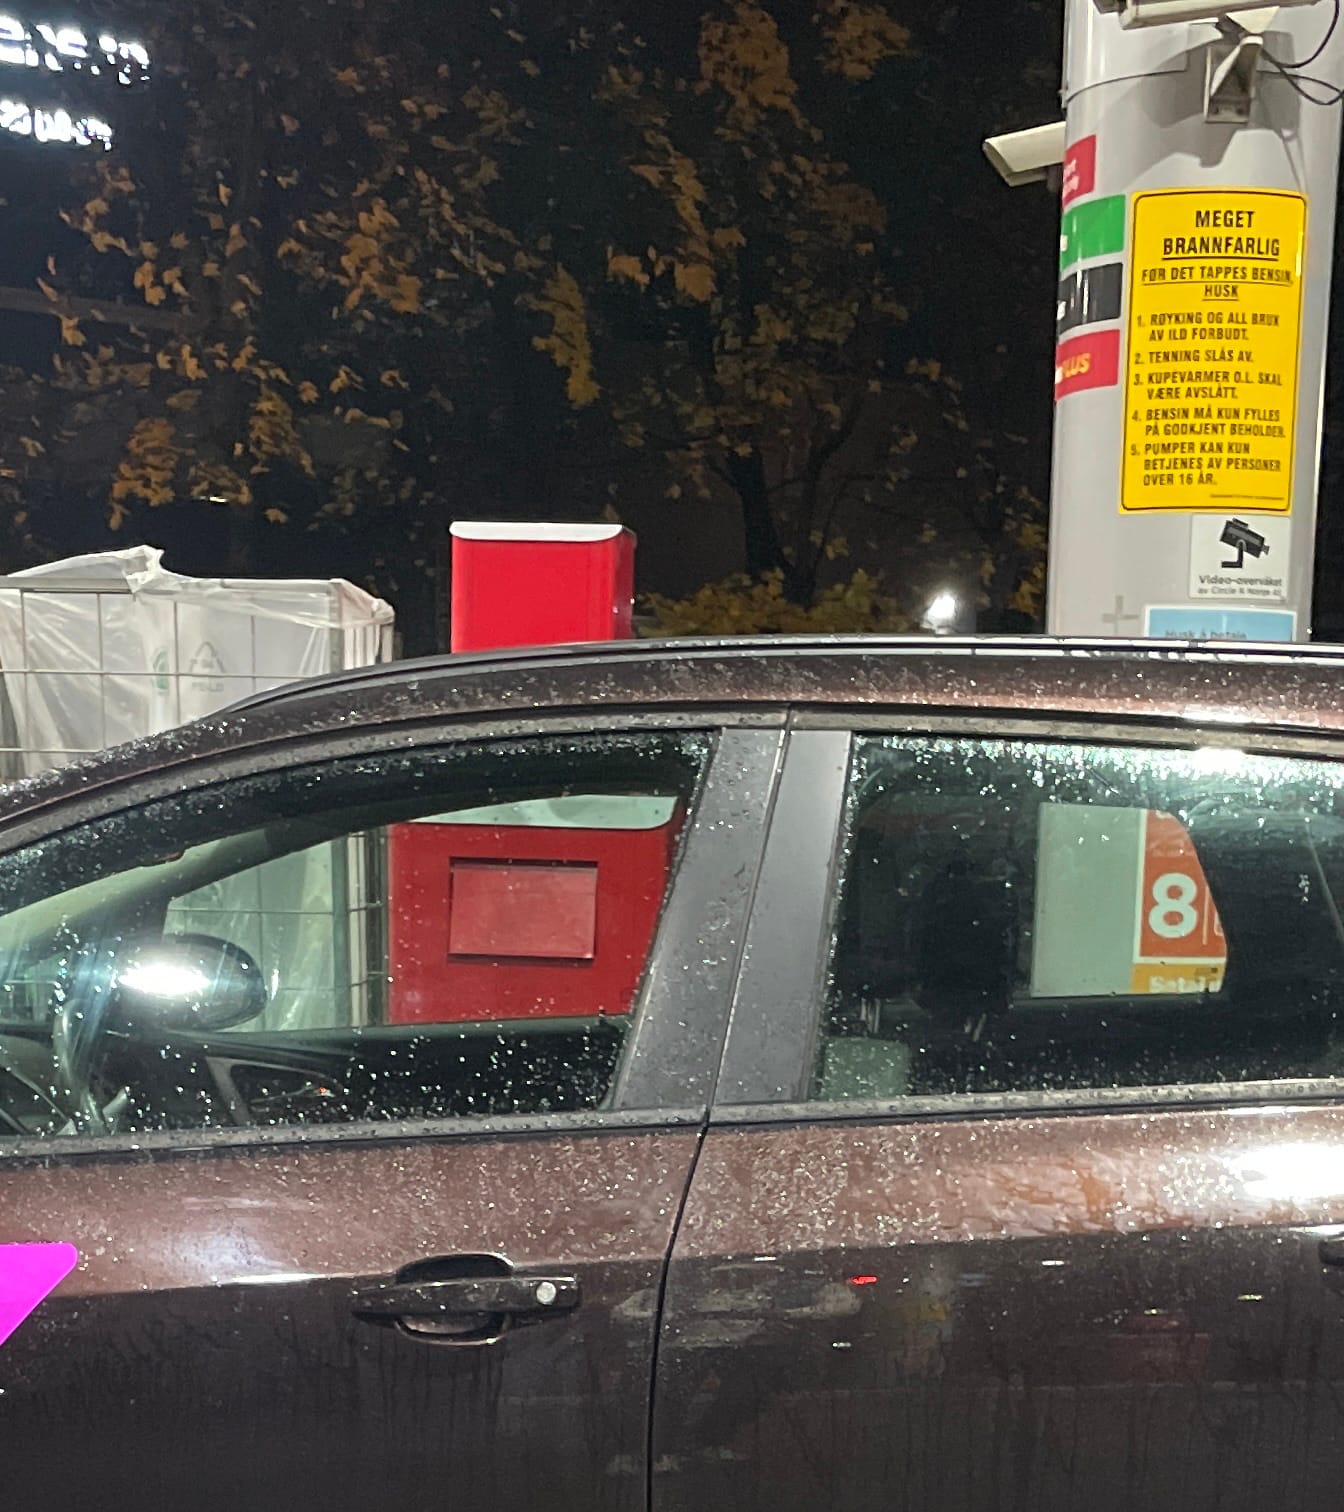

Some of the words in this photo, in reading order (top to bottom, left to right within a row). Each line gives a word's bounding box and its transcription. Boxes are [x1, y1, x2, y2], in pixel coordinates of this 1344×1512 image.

[1195, 210, 1255, 228] MEGET
[1163, 237, 1280, 256] BRANNFARLIG
[1171, 266, 1194, 280] DET
[1200, 266, 1247, 280] TAPPES
[1204, 285, 1238, 297] HUSK
[1207, 312, 1223, 324] OG
[1228, 312, 1247, 324] ALL
[1251, 313, 1279, 326] BRUK
[1149, 329, 1164, 341] AV
[1169, 329, 1187, 341] ILD
[1149, 350, 1200, 363] TENNING
[1147, 371, 1230, 384] KUPEVARMER
[1258, 372, 1282, 386] SKAL
[1147, 387, 1180, 400] VÆRE
[1146, 408, 1189, 421] BENSIN
[1194, 404, 1212, 419] MÅ
[1217, 408, 1240, 419] KUN
[1244, 409, 1280, 422] FYLLES
[1145, 421, 1159, 436] PÅ
[1164, 423, 1226, 436] GODKJENT
[1145, 442, 1195, 455] PUMPER
[1200, 442, 1223, 454] KAN
[1228, 442, 1250, 454] KUN
[1144, 457, 1203, 470] BETJENES
[1207, 458, 1222, 469] AV
[1143, 473, 1174, 486] OVER
[1179, 474, 1193, 485] 16
[1148, 872, 1198, 939] 8
